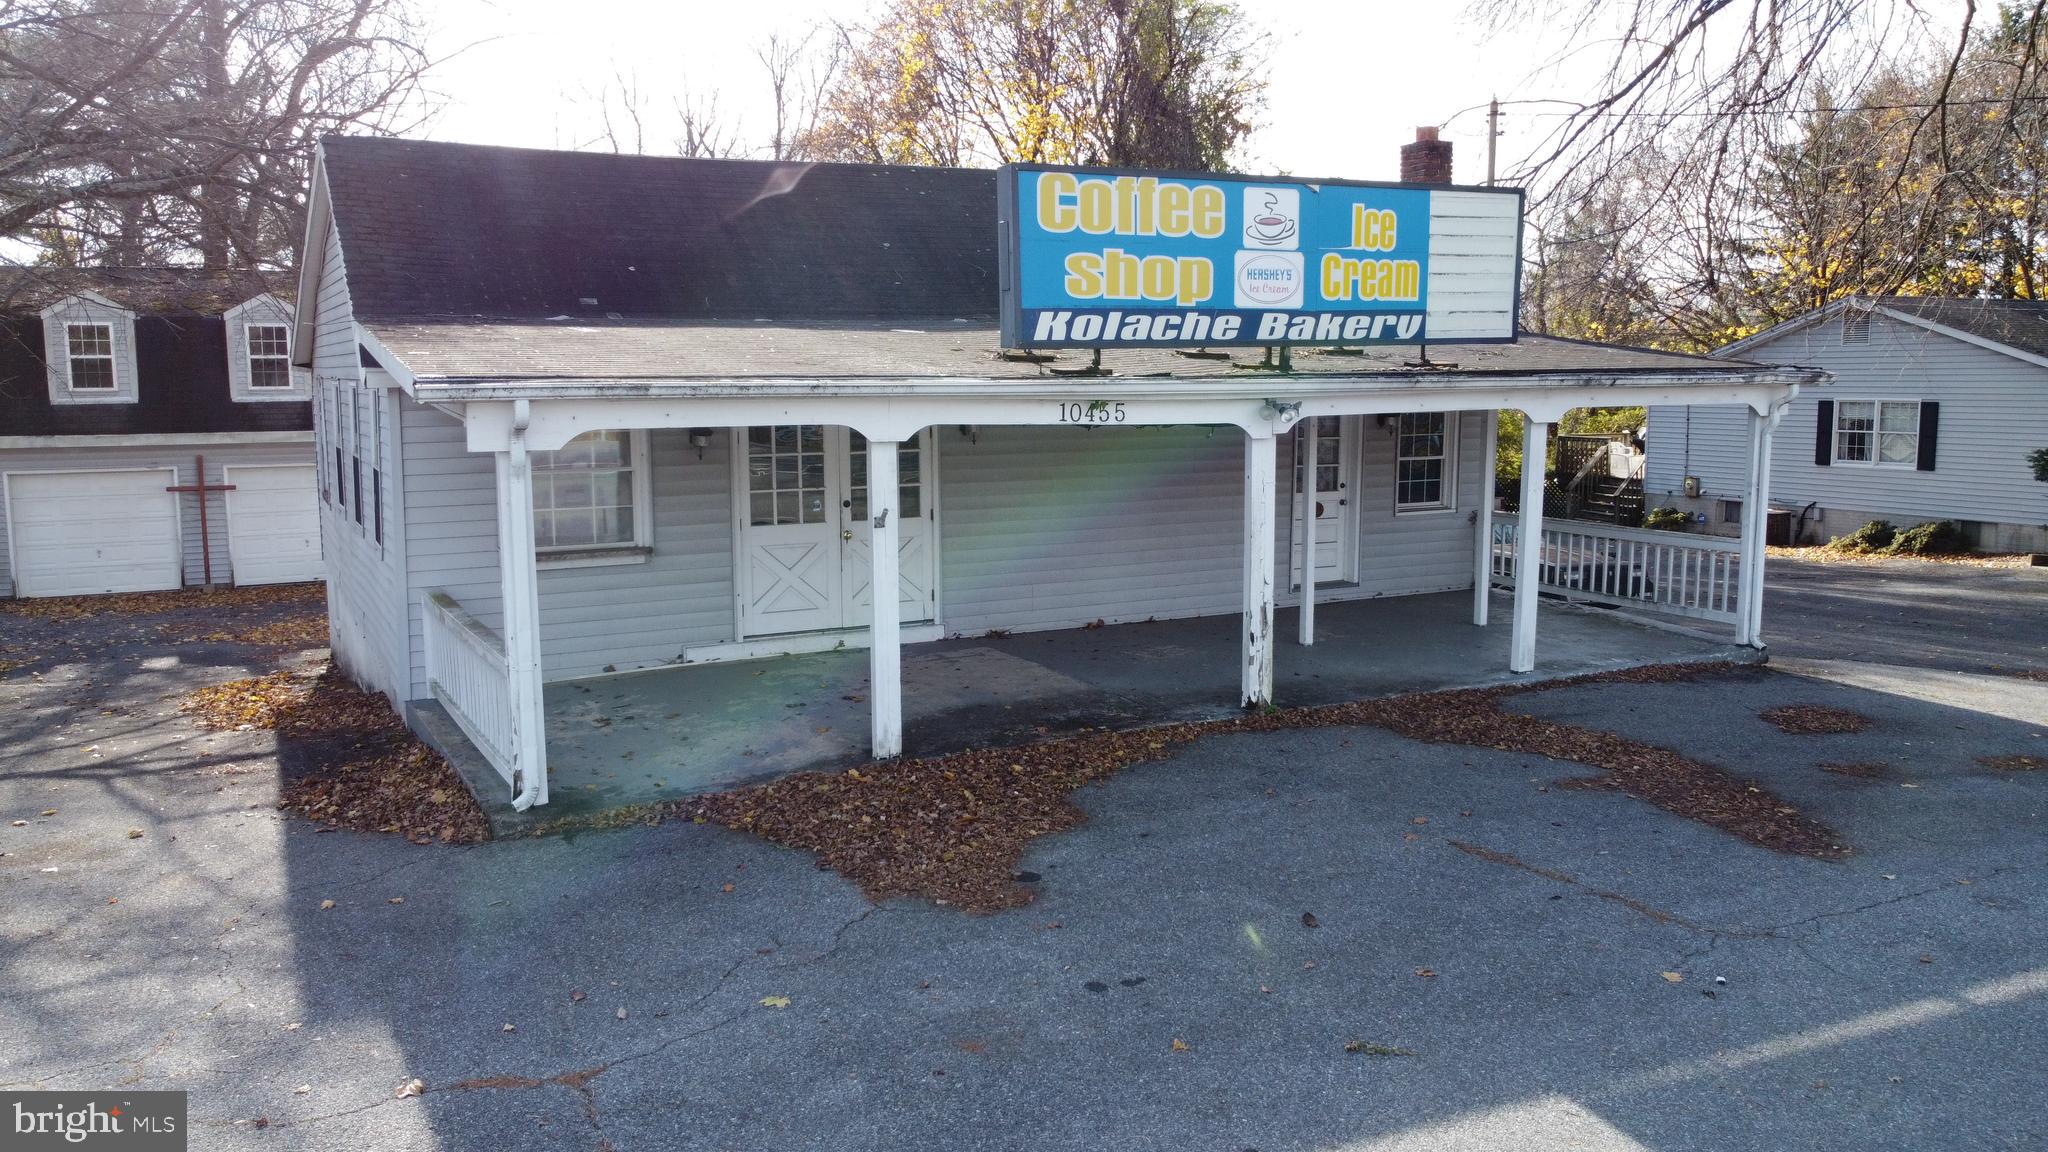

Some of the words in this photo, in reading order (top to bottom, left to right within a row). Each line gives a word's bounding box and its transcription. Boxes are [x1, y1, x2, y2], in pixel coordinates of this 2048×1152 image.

[1037, 172, 1225, 238] Coffee
[1352, 203, 1397, 252] Ice
[1064, 248, 1213, 306] shop
[1247, 268, 1292, 281] HERSHEY'S
[1249, 283, 1260, 294] Ice
[1262, 283, 1290, 296] Cream
[1321, 252, 1420, 301] Cream
[1033, 311, 1242, 341] Kolache
[1256, 312, 1423, 340] Bakery
[1059, 402, 1126, 422] 10455
